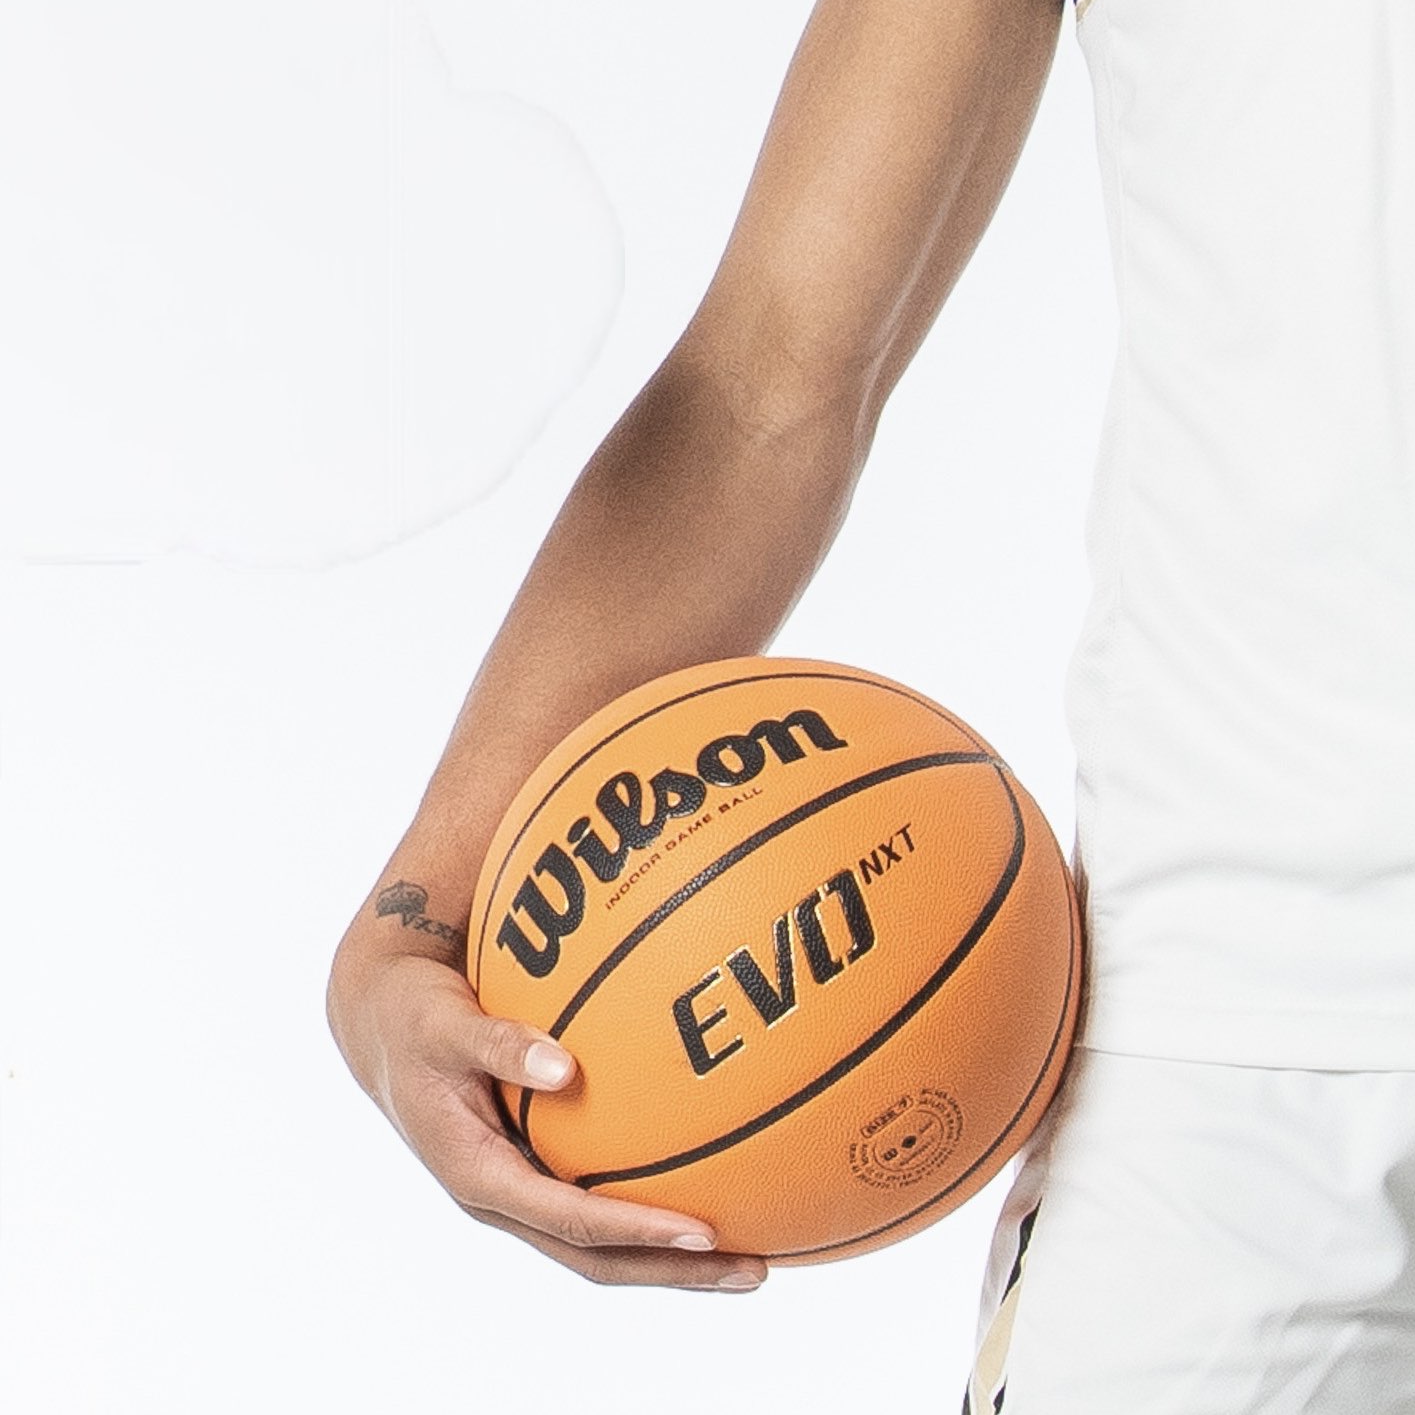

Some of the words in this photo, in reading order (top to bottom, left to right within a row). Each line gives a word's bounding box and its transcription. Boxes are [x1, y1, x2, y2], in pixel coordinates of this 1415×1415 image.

[496, 709, 849, 979] Wilson
[605, 852, 662, 910] INDOOR
[665, 813, 713, 851] GAME
[718, 787, 763, 814] BALL
[672, 868, 878, 1080] EVO
[858, 823, 918, 885] NXT
